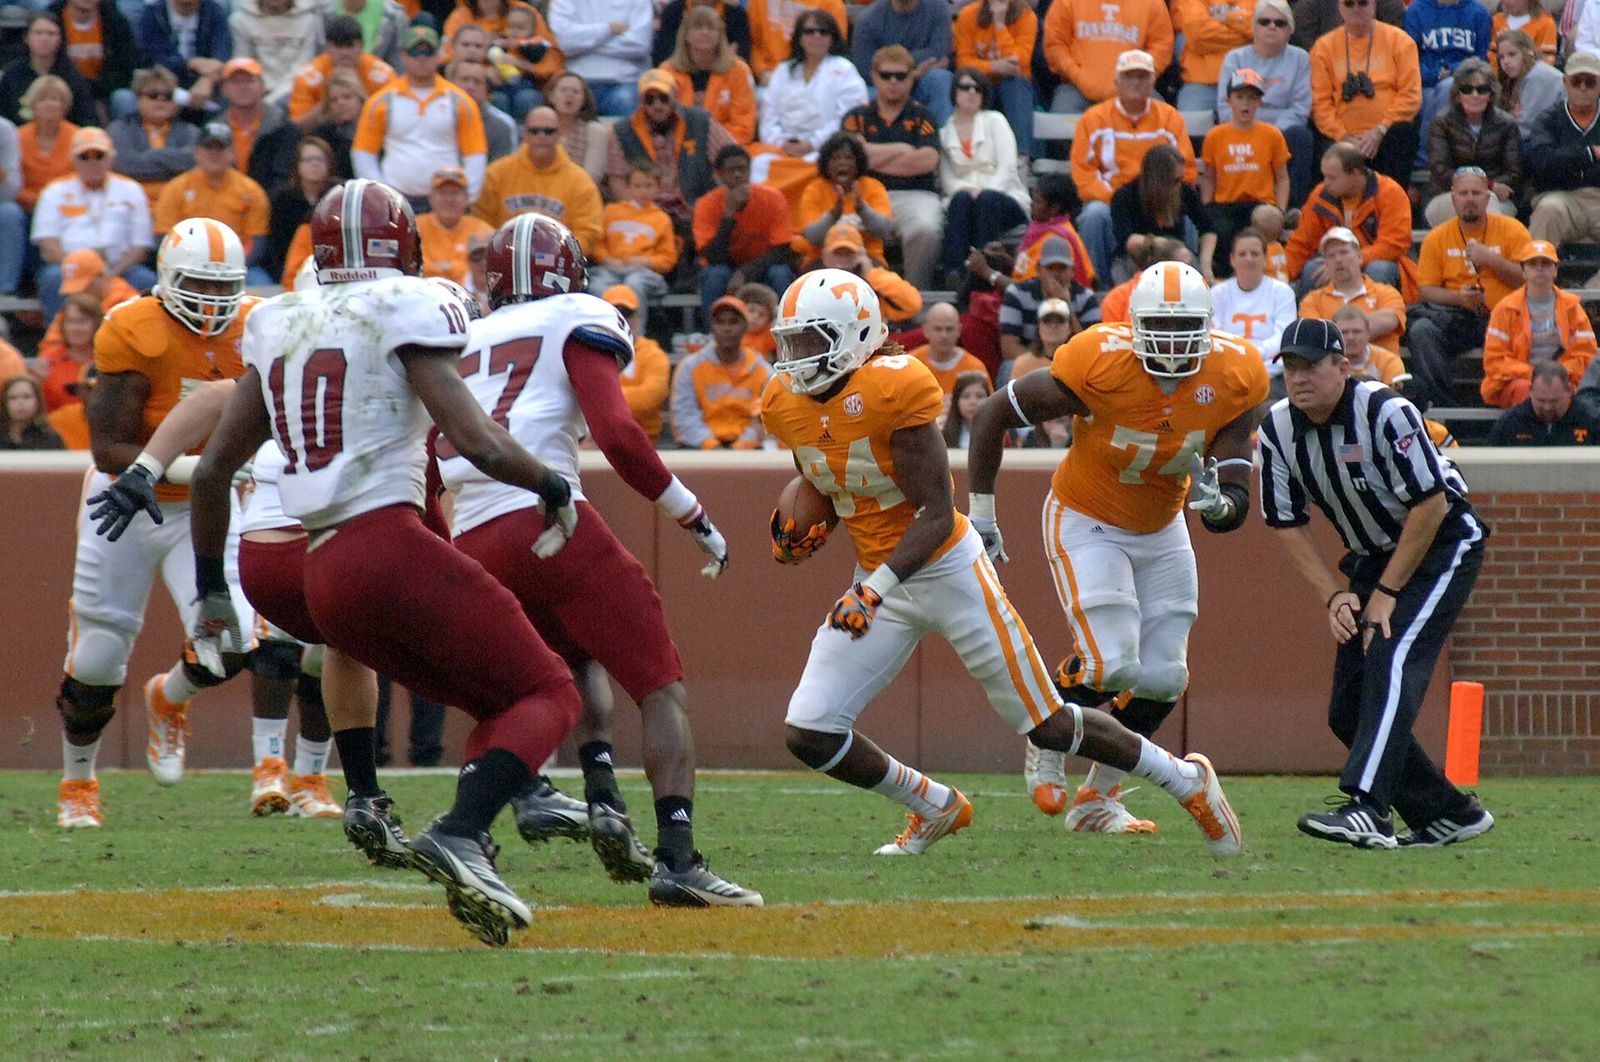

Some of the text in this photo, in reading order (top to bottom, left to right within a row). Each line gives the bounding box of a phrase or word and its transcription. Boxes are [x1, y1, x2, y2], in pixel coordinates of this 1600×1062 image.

[1228, 143, 1254, 156] VOL
[329, 270, 377, 280] Riddell
[438, 302, 466, 334] 10
[1231, 312, 1267, 338] T
[844, 394, 863, 416] SEC
[1196, 386, 1215, 405] SEC
[268, 348, 348, 475] 10
[1573, 428, 1589, 443] T
[1110, 425, 1206, 485] 74
[797, 436, 906, 517] 84
